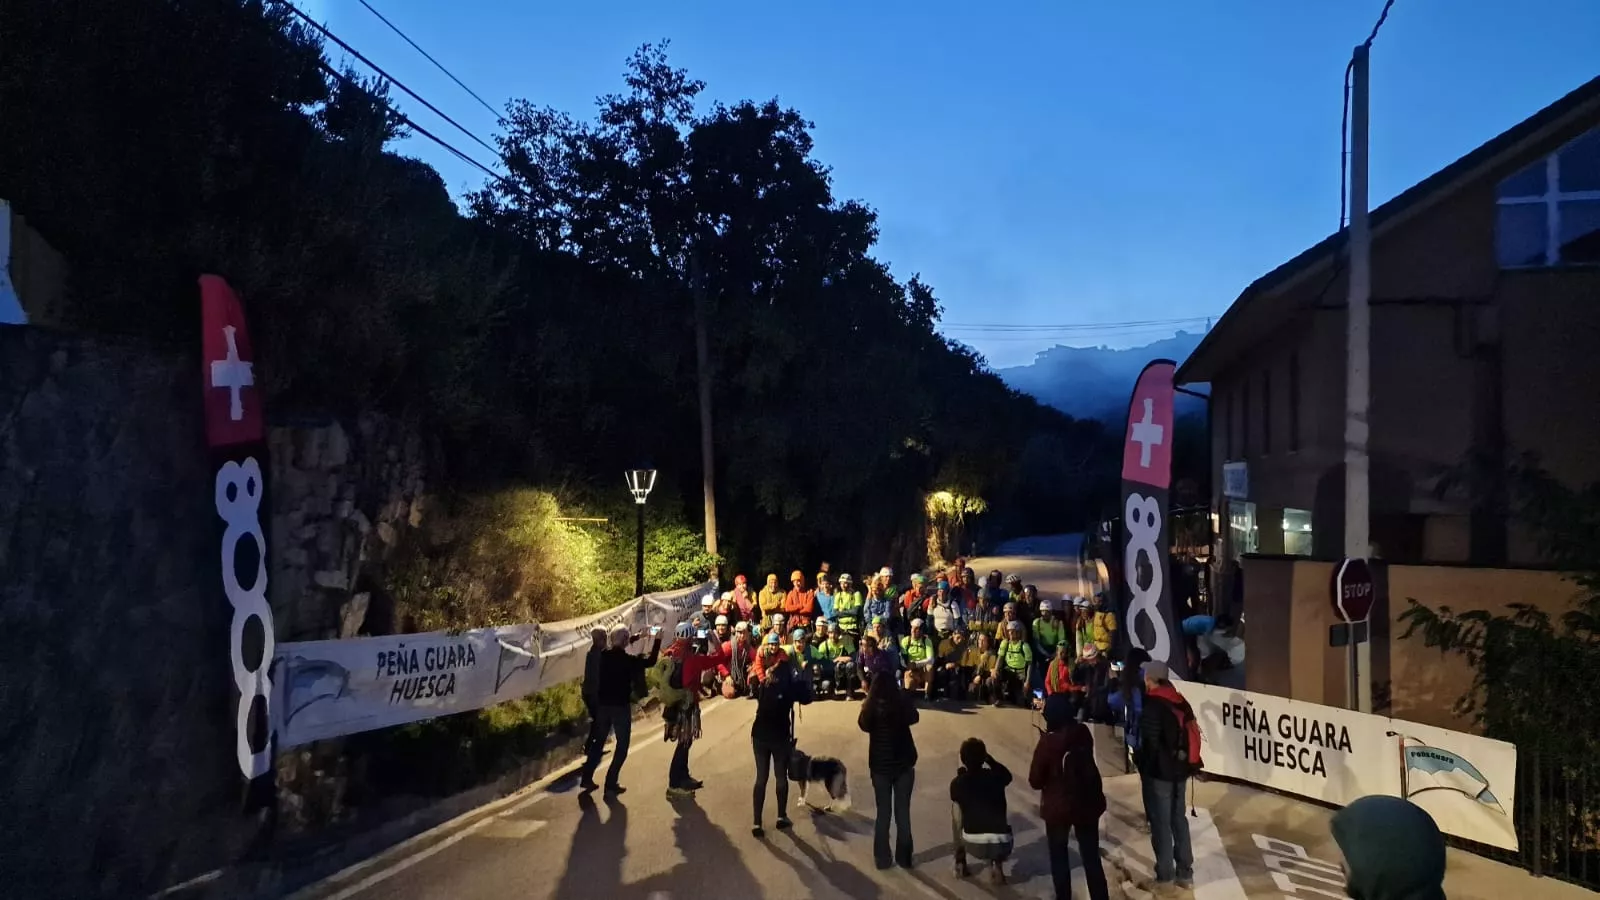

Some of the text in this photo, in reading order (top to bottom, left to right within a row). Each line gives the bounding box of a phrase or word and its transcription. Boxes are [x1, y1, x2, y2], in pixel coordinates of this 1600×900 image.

[1344, 582, 1372, 599] STOP
[376, 643, 476, 680] PEÑA GUARA
[389, 672, 456, 705] HUESCA
[1222, 700, 1353, 754] PEÑA GUARA
[1244, 735, 1327, 778] HUESCA
